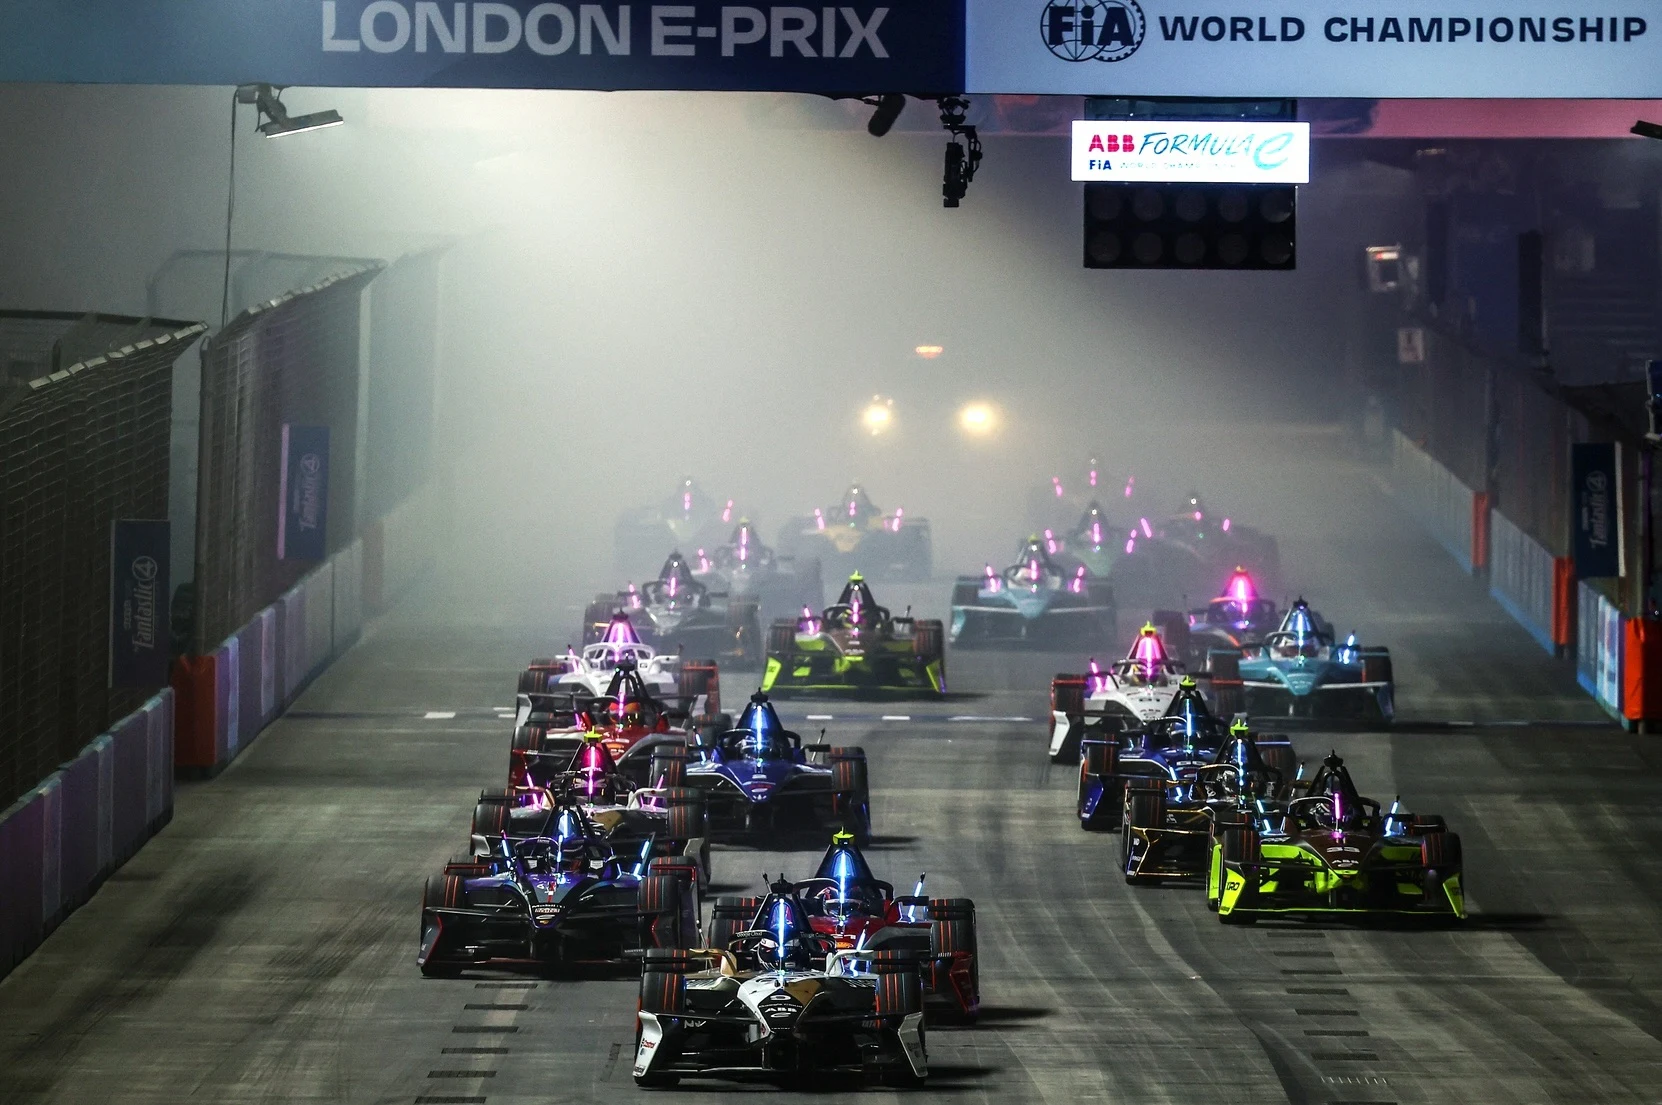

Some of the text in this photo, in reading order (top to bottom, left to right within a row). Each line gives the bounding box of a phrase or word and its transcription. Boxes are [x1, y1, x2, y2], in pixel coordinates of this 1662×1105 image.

[321, 0, 890, 58] LONDON E-PRIX
[1159, 15, 1306, 42] WORLD
[1324, 16, 1648, 43] CHAMPIONSHIP
[1088, 133, 1136, 153] ABB
[1138, 132, 1256, 156] FORMULA
